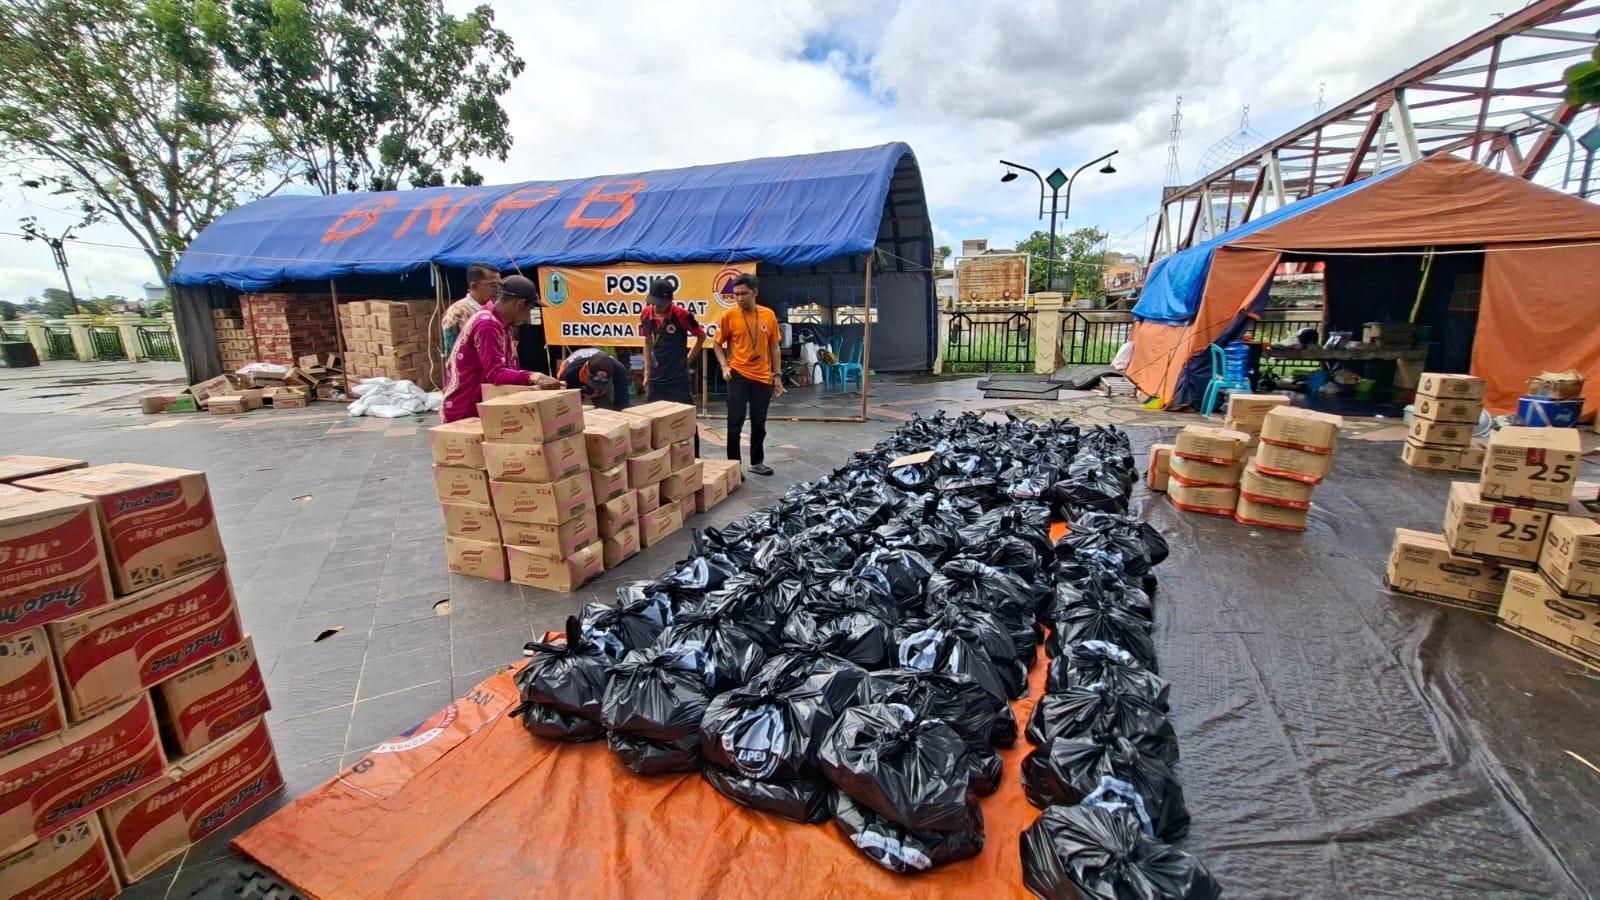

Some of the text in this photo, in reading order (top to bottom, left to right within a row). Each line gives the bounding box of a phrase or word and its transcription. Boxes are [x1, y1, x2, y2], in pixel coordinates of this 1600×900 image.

[321, 179, 647, 244] BNPB
[582, 302, 628, 315] SIAGA
[563, 324, 634, 337] BENCANA
[1528, 464, 1571, 483] 25
[1498, 522, 1538, 542] 25
[1576, 581, 1587, 592] 7
